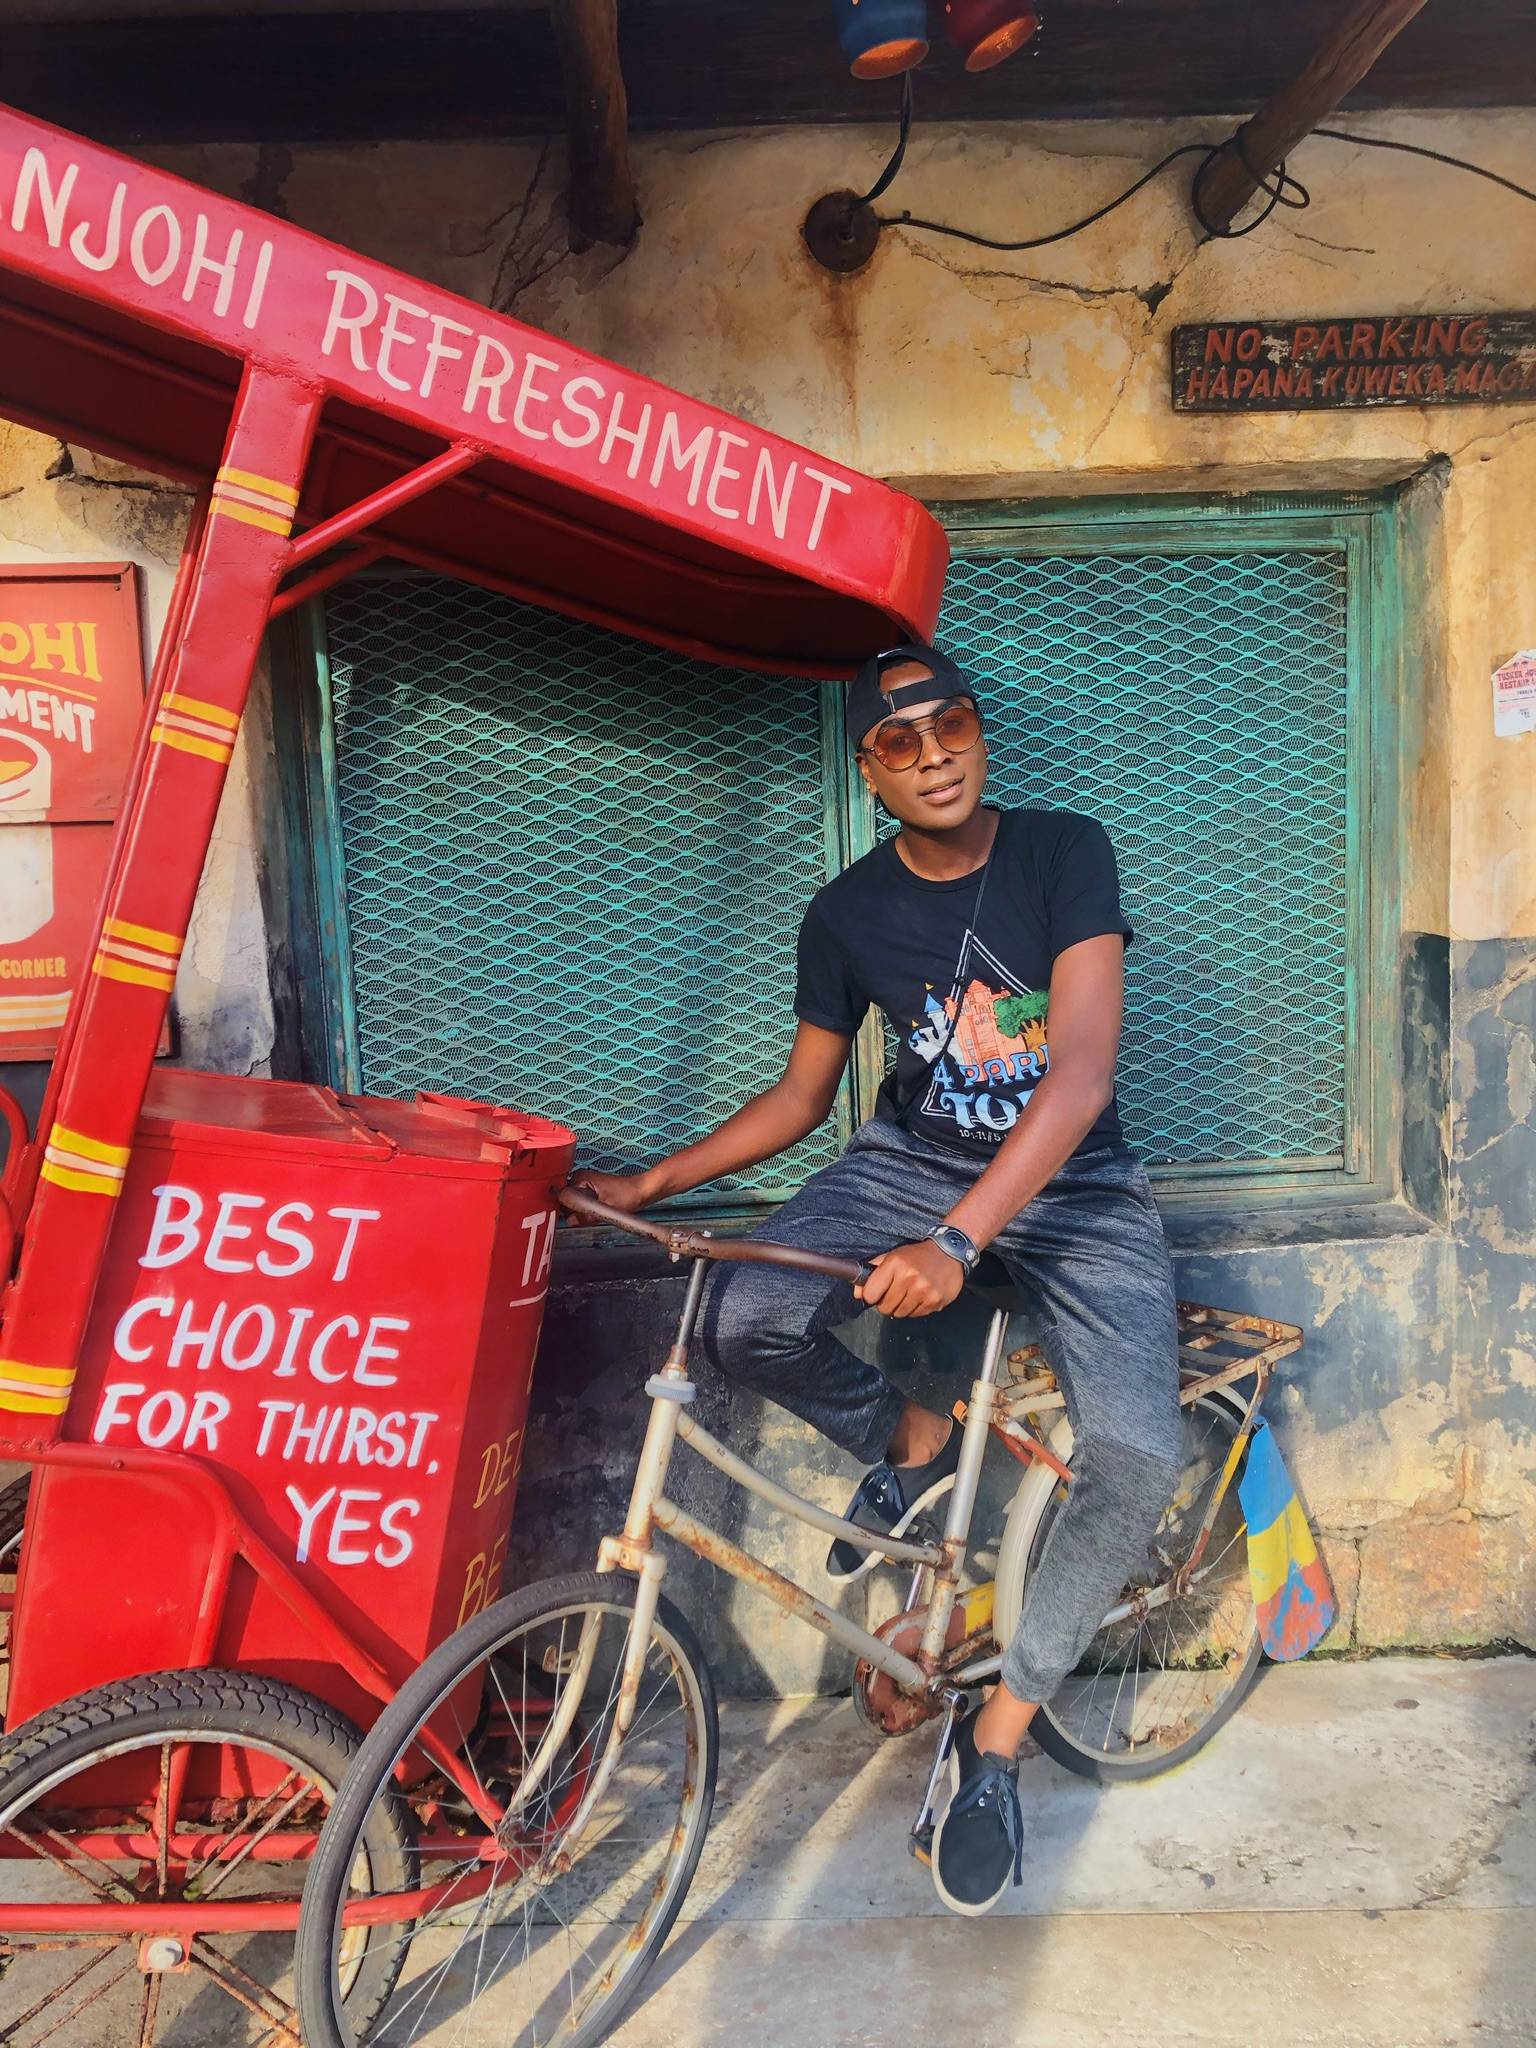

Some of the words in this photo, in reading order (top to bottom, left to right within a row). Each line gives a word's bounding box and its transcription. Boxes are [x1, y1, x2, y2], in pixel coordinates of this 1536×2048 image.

[0, 146, 273, 329] NJOHI
[320, 269, 852, 551] REFRESHMENT
[1204, 327, 1265, 363] NO
[1292, 318, 1488, 360] PARKING
[1187, 366, 1314, 399] HAPANA
[1322, 361, 1447, 397] KUWEKA
[0, 956, 67, 979] CORNER
[138, 1184, 382, 1282] BEST
[114, 1295, 410, 1387] CHOICE
[93, 1383, 232, 1451] FOR
[285, 1484, 420, 1568] YES
